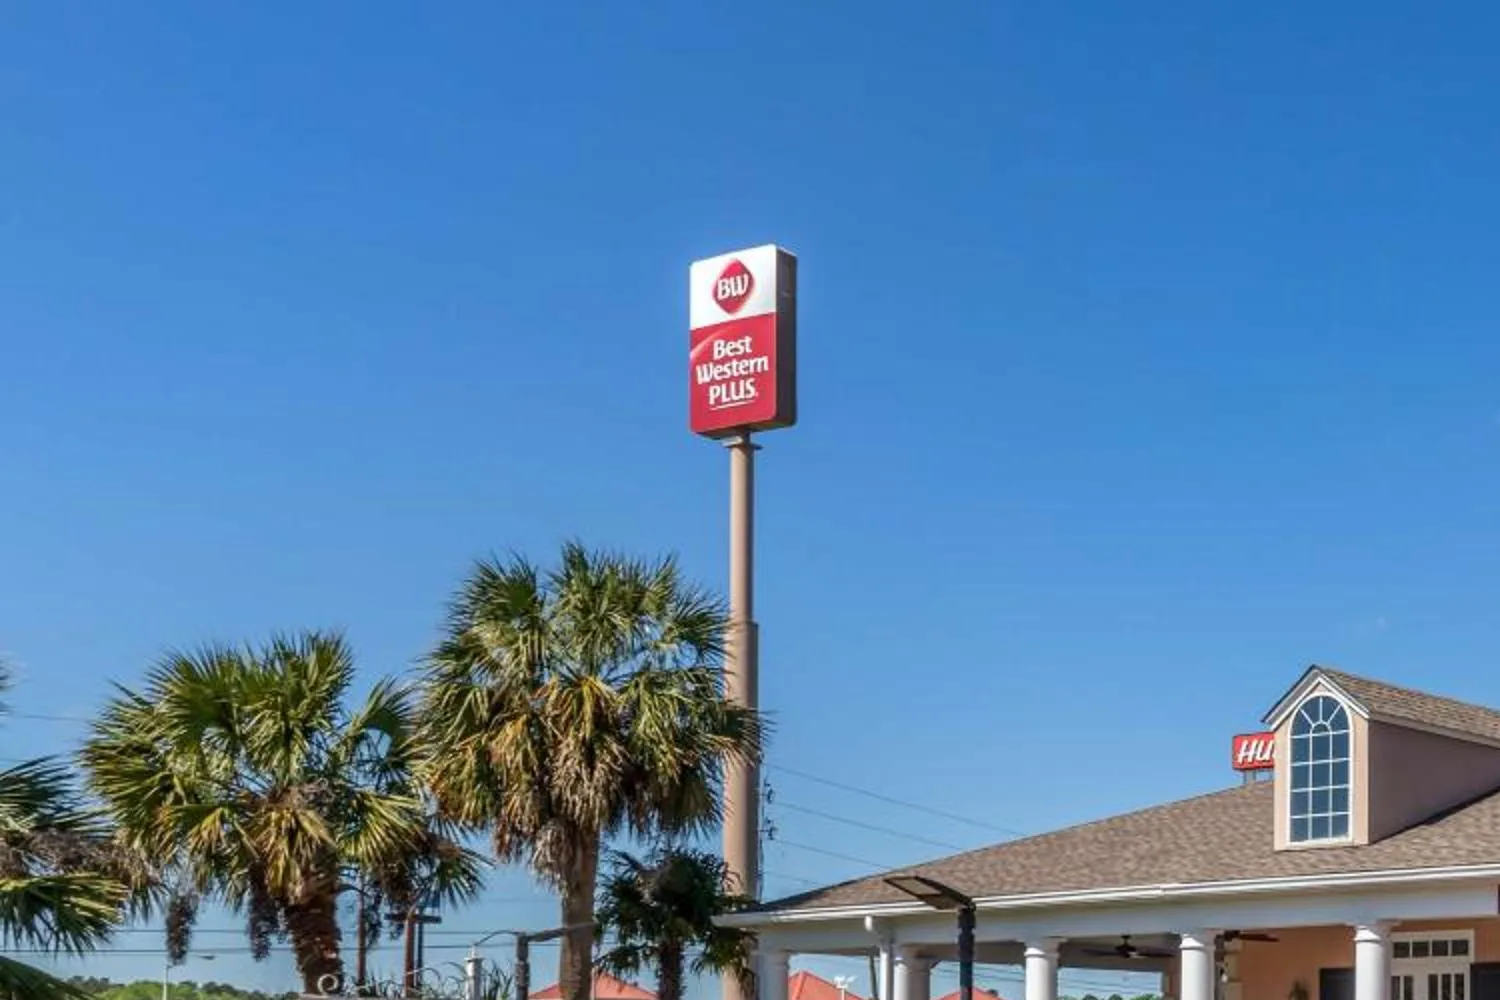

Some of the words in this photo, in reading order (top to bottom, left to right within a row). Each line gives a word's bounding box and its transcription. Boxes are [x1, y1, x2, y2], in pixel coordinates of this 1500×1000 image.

[716, 273, 749, 300] BW
[713, 335, 753, 360] Best
[696, 355, 769, 384] Western
[1238, 739, 1275, 764] HU
